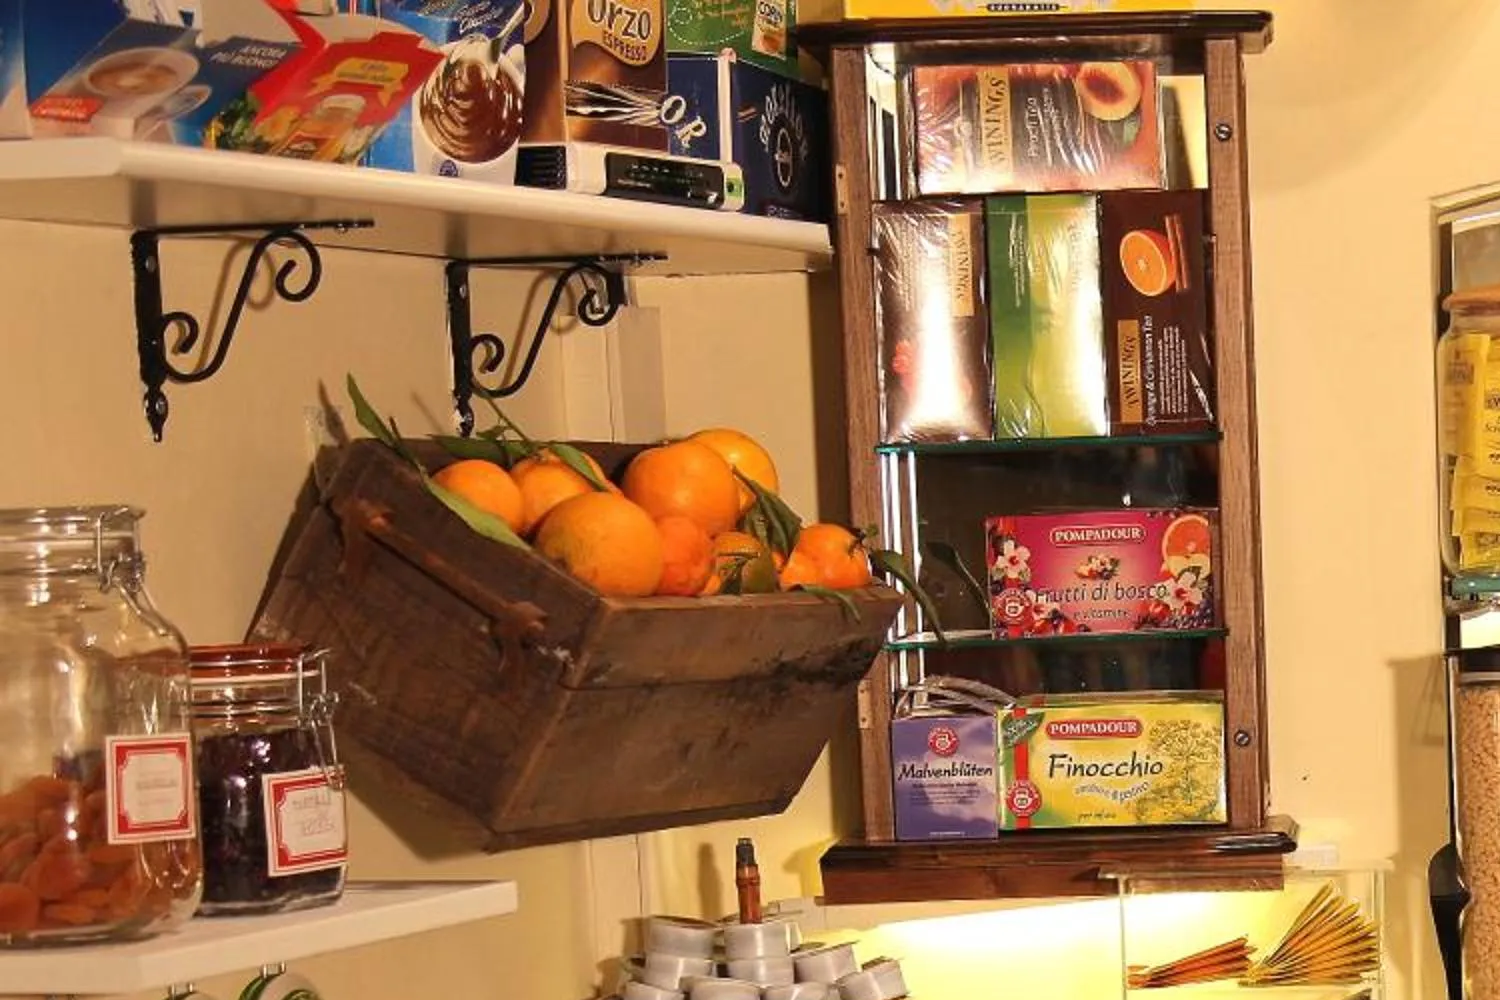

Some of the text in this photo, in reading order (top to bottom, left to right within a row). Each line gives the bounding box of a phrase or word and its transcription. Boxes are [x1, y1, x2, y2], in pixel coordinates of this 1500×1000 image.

[984, 76, 1007, 166] WININGS
[1121, 334, 1140, 408] TWININGS
[1055, 527, 1142, 542] POMPADOUR
[1035, 581, 1167, 603] Frutti di bosco
[1050, 721, 1138, 735] POMPADOUR
[898, 762, 993, 781] Malvenblüten
[1048, 751, 1164, 778] Finocchio
